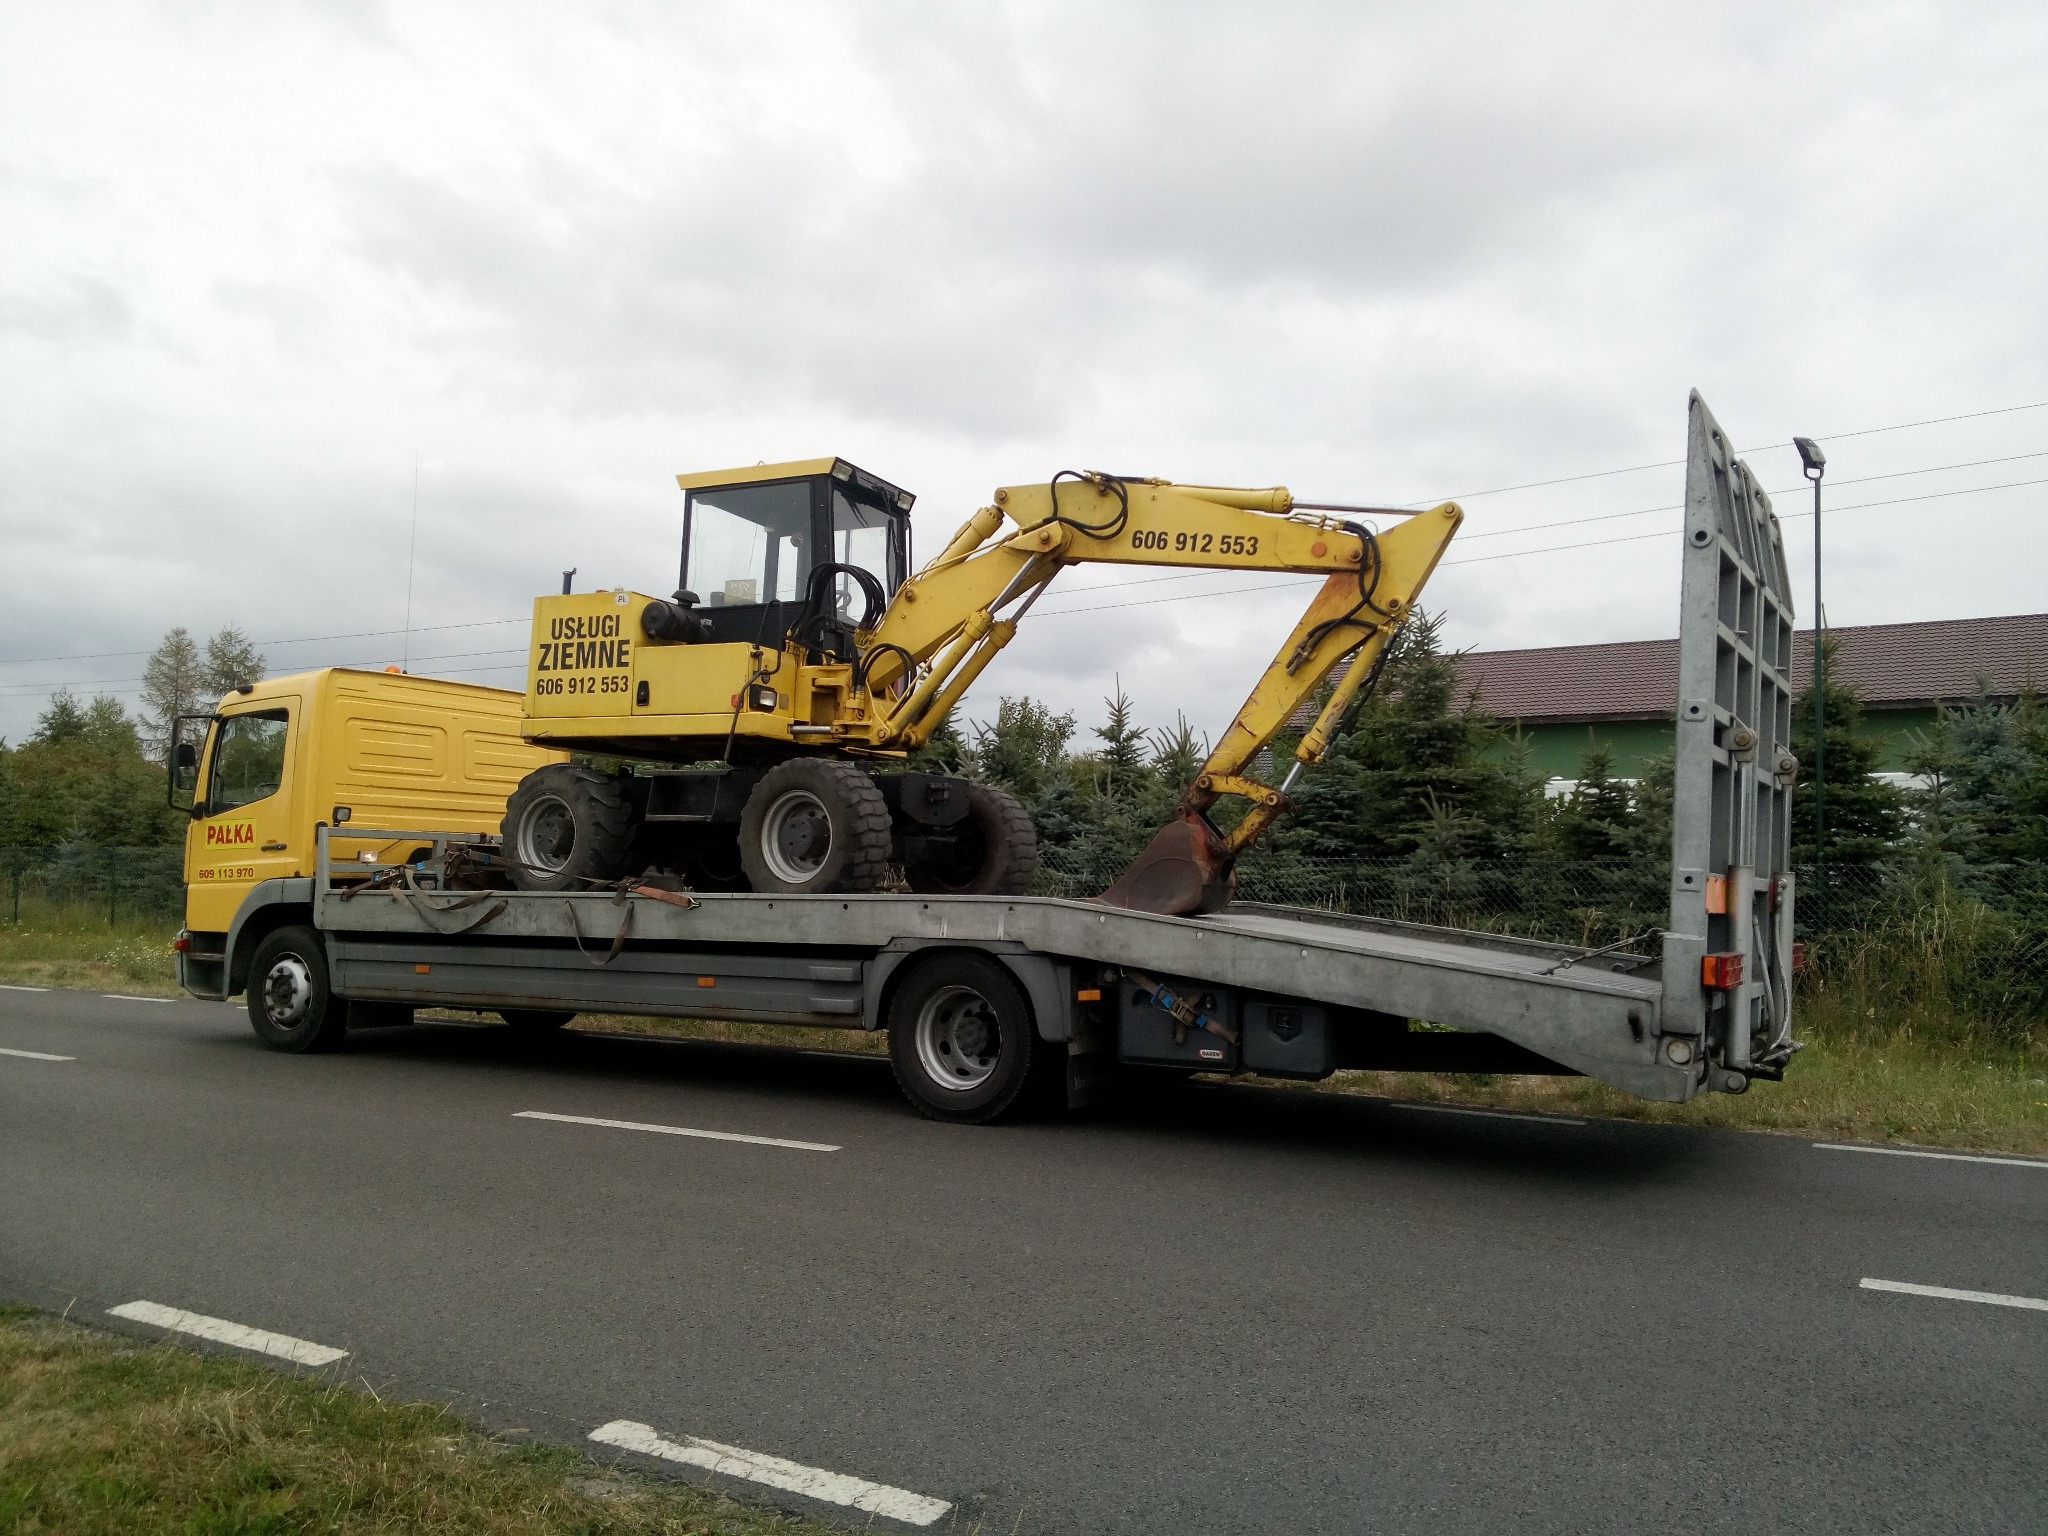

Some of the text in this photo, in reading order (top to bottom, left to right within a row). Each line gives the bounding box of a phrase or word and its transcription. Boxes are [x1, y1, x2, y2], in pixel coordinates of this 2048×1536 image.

[1131, 530, 1258, 555] 606 912 553
[618, 595, 626, 603] PL
[551, 614, 620, 640] USŁUGI
[537, 639, 630, 671] ZIEMNE
[536, 675, 628, 695] 606 912 553
[207, 824, 253, 845] PAŁKA
[199, 868, 253, 878] 609 113 970
